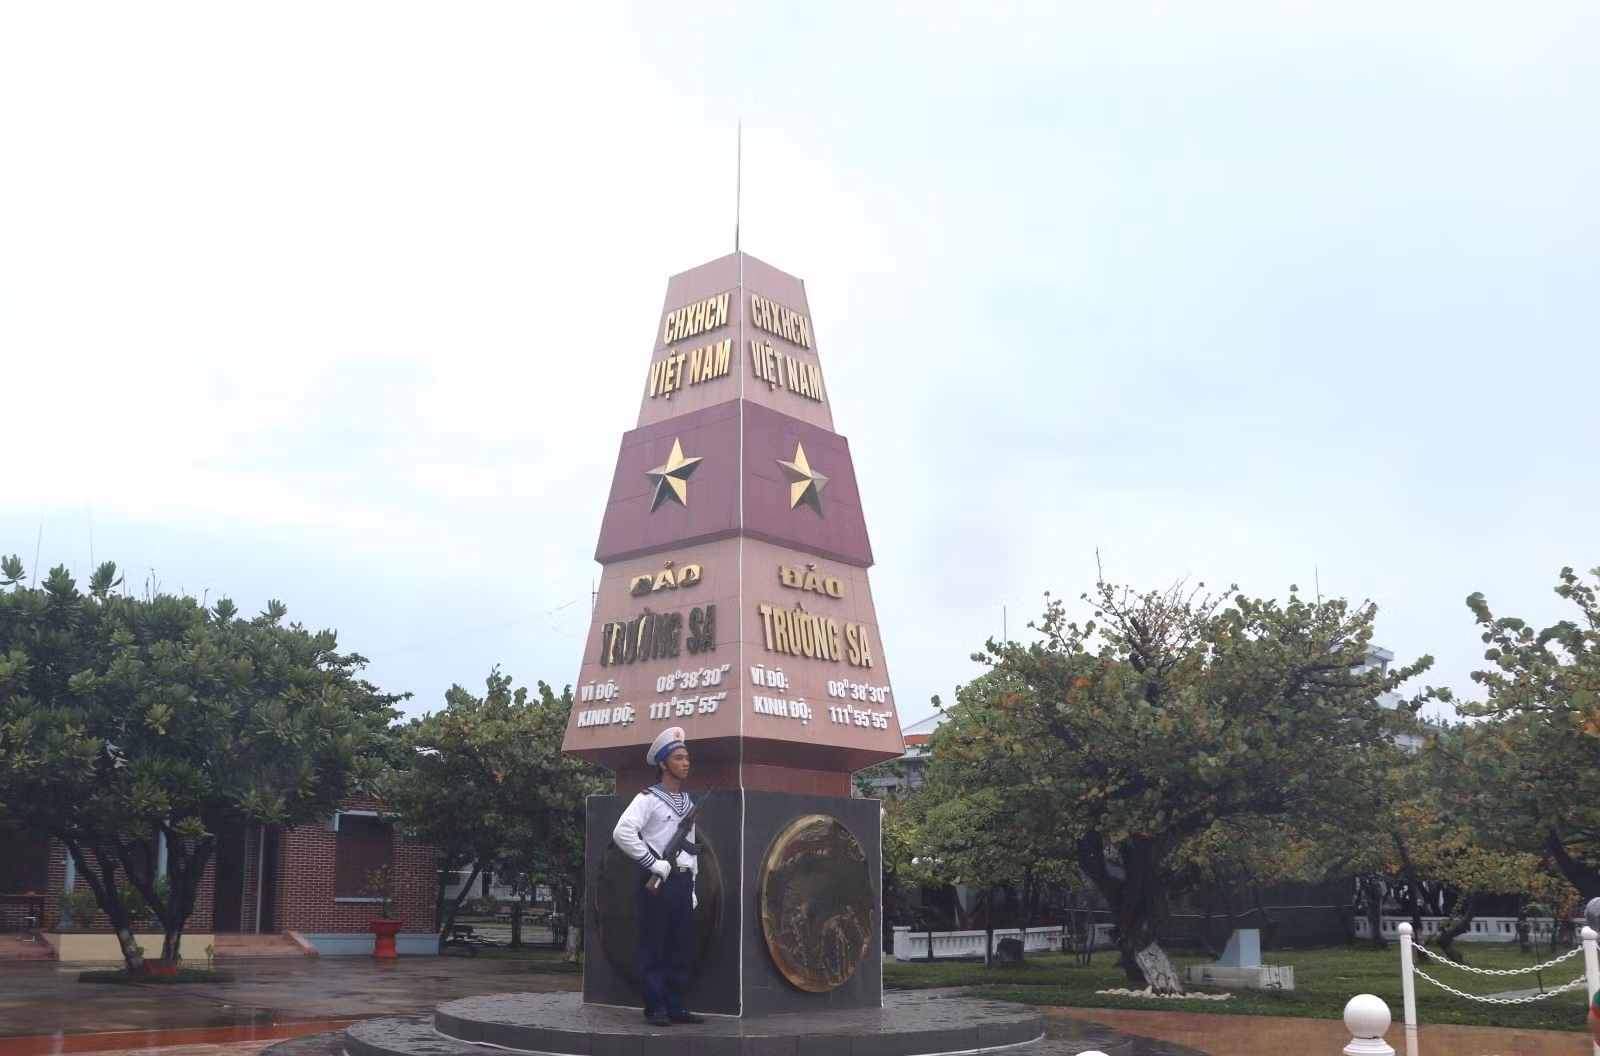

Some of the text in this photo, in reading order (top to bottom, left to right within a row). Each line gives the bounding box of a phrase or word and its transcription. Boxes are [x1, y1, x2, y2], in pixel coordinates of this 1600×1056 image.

[663, 293, 731, 345] CHXHCN
[750, 293, 811, 349] CHXHCN
[650, 339, 732, 400] VIỆT NAM
[751, 339, 823, 402] VIỆT NAM
[779, 563, 846, 599] ĐẢO
[686, 605, 716, 654] SA
[759, 601, 873, 668] TRƯỜNG SA
[577, 710, 610, 728] KINH
[753, 695, 788, 717] KINH
